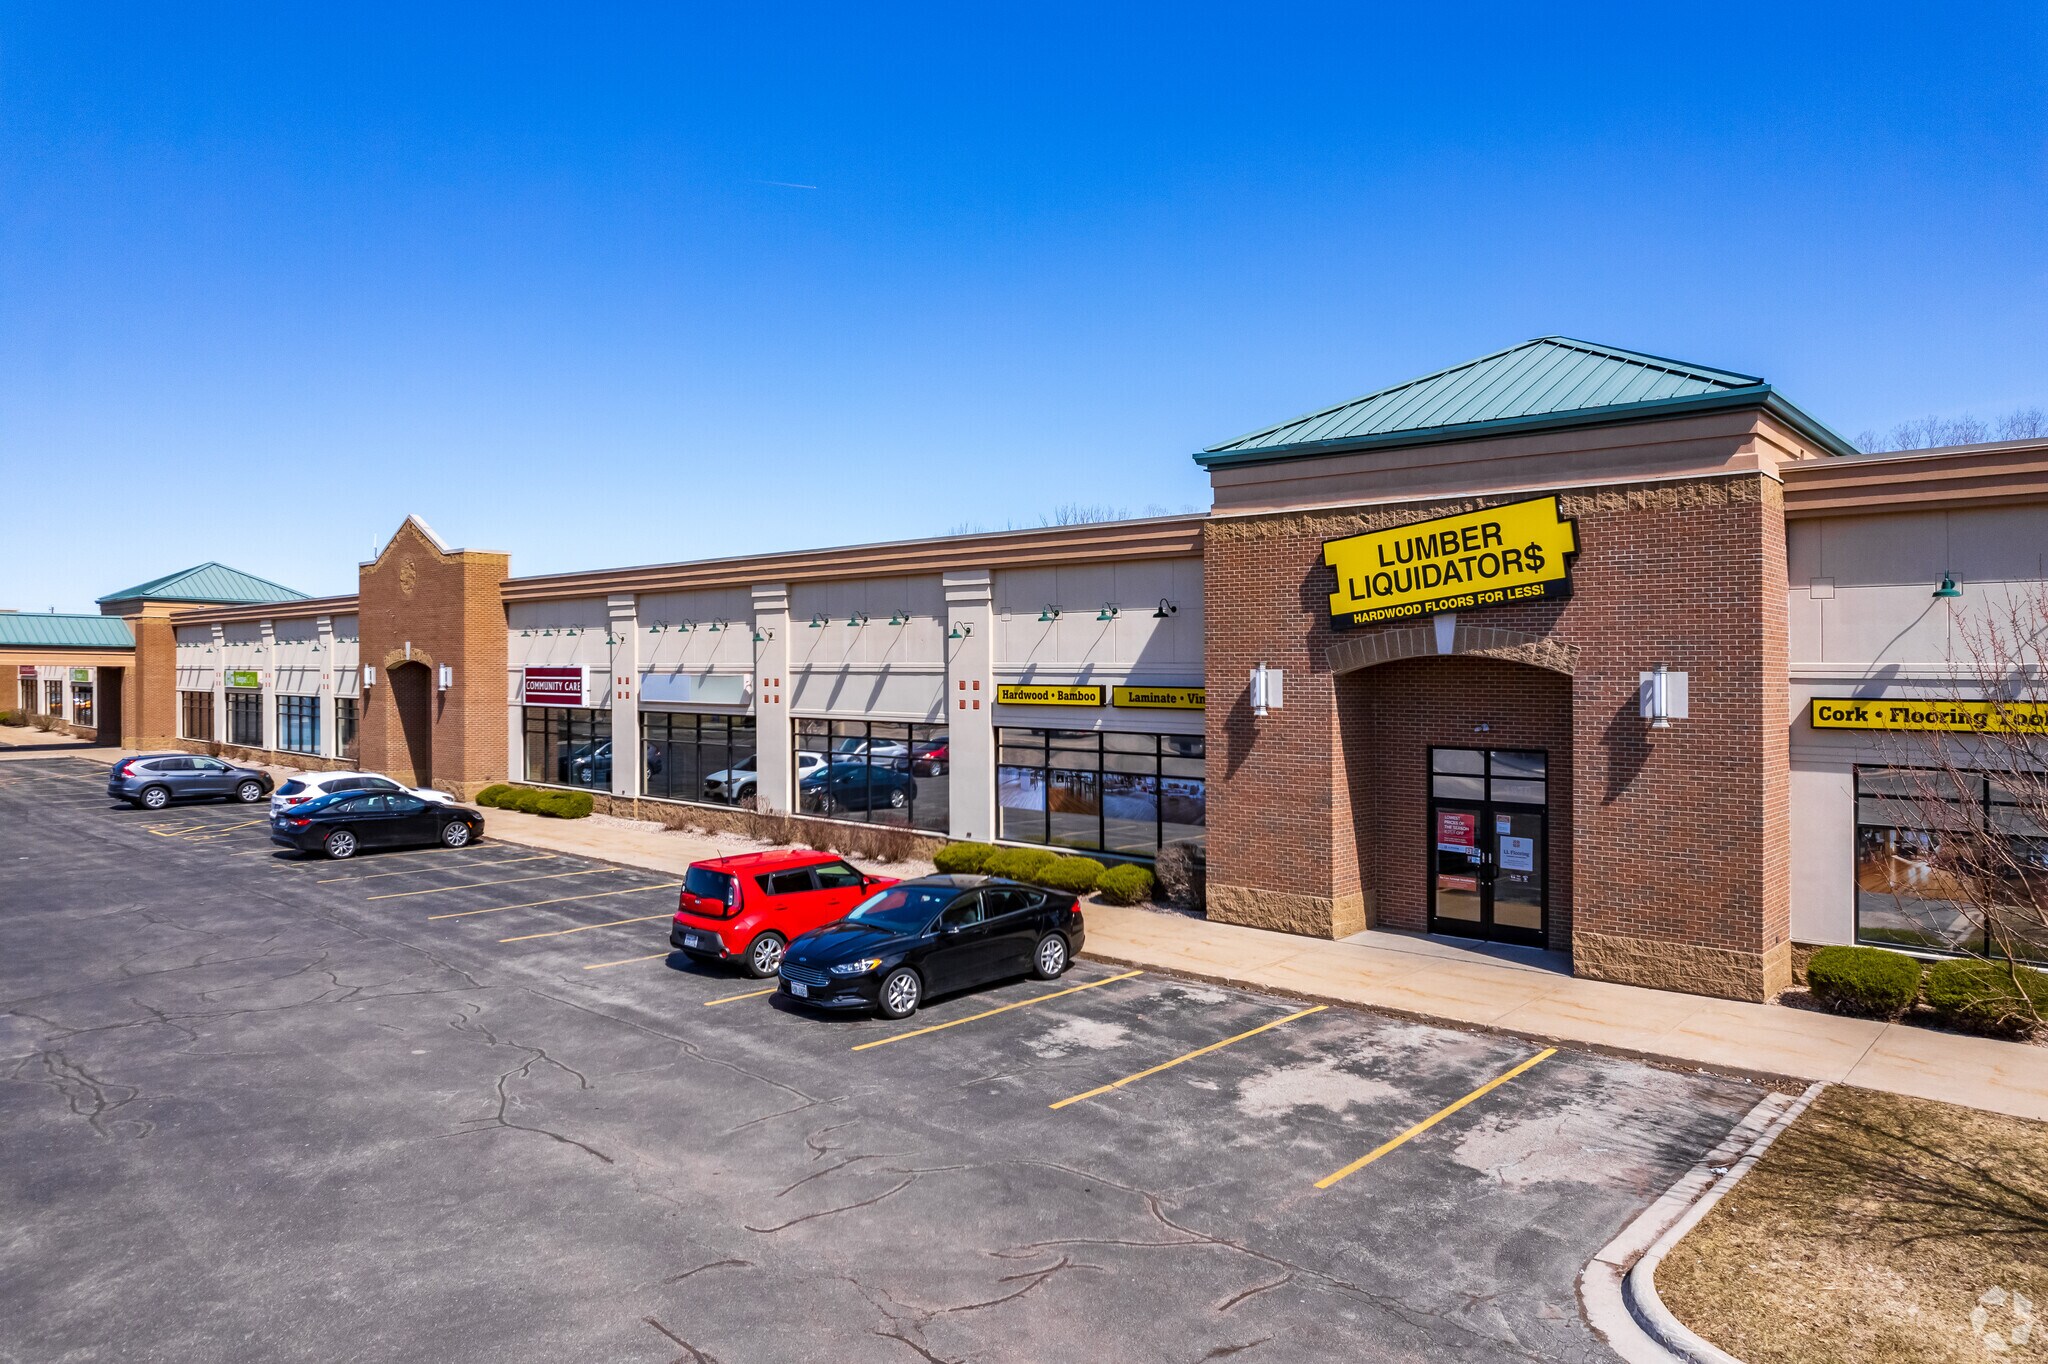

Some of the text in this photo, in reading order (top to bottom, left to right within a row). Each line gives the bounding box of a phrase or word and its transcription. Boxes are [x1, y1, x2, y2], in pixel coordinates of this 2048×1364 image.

[1378, 521, 1503, 567] LUMBER
[1348, 541, 1546, 601] LIQUIDATOR$
[1353, 584, 1545, 624] HARDWOOD FLOORS FOR LESS!
[526, 680, 581, 691] COMMUNITY CARE
[1002, 689, 1096, 701] Hardwood Bamboo
[1128, 691, 1177, 704] Laminate
[1818, 705, 1869, 722] Cork
[1889, 706, 1988, 729] Flooring
